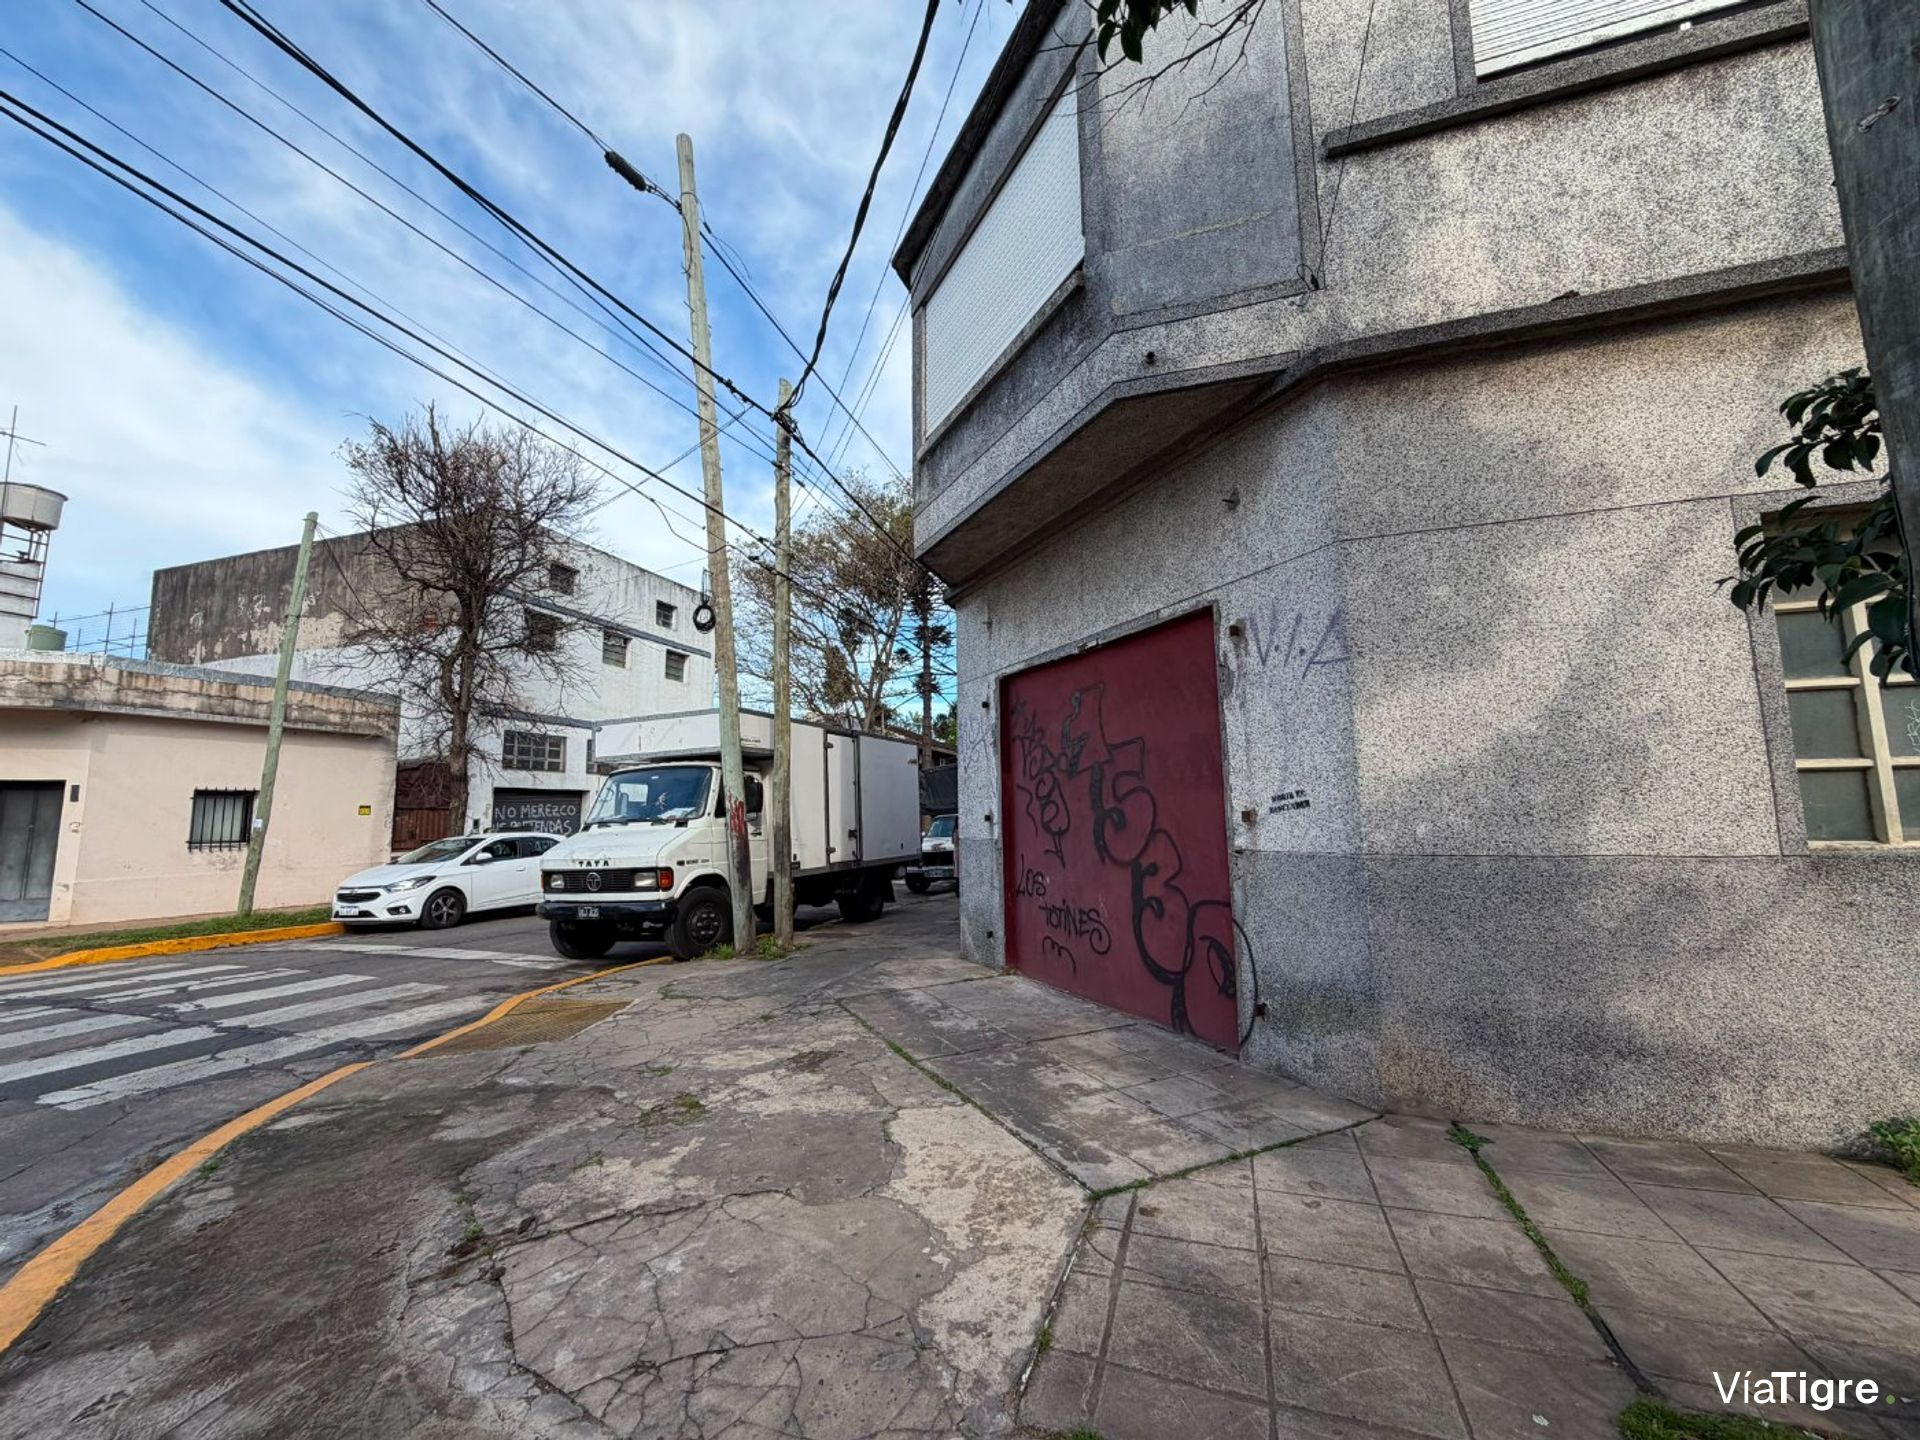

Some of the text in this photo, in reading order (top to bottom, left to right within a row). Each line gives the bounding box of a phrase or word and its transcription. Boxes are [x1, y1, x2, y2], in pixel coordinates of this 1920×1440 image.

[495, 803, 576, 820] NO MEREZCO
[1016, 853, 1047, 897] LOS
